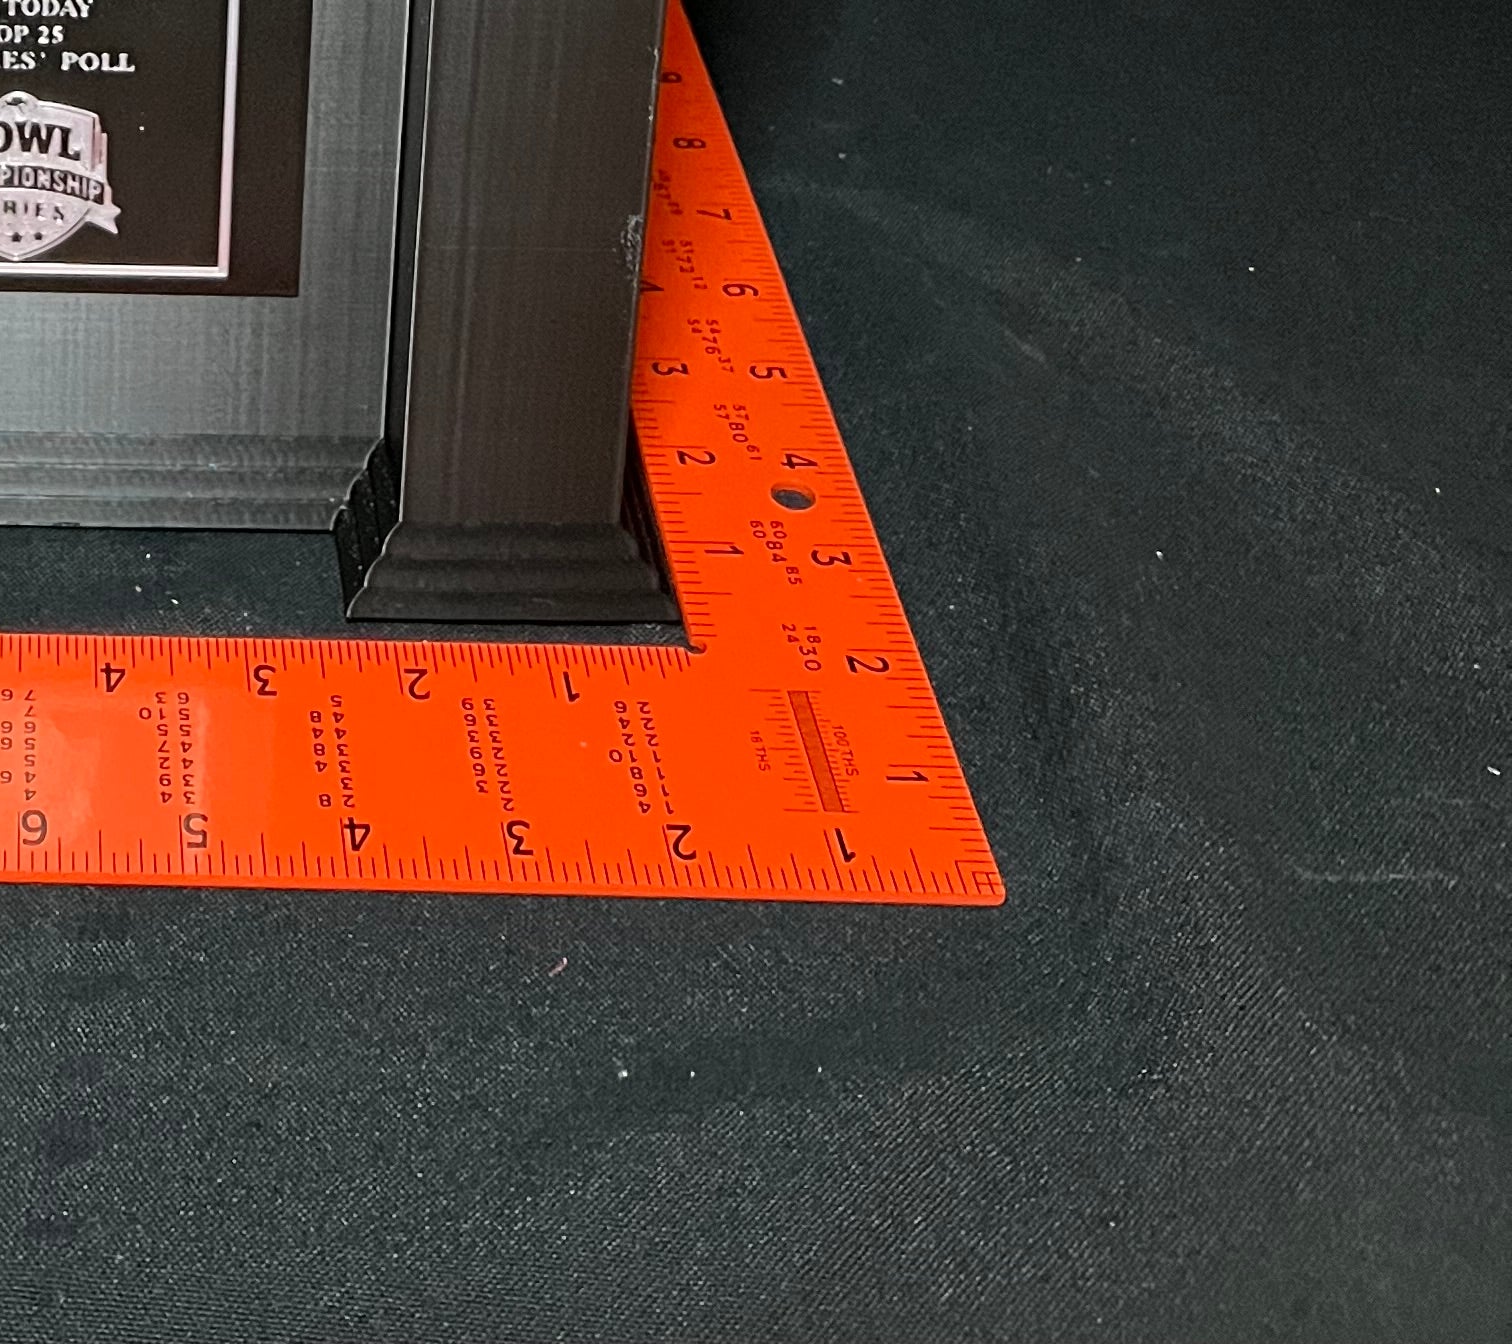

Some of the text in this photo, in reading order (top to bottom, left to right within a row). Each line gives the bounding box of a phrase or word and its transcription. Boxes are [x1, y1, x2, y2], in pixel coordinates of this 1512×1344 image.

[37, 25, 64, 44] 25
[60, 51, 136, 72] POLL
[651, 362, 689, 376] 3
[677, 450, 716, 465] 2
[704, 545, 745, 555] 1
[672, 137, 707, 149] 8
[696, 208, 733, 221] 7
[722, 283, 759, 297] 6
[749, 365, 788, 380] 5
[780, 453, 818, 470] 4
[811, 549, 853, 566] 3
[846, 655, 889, 673] 2
[886, 771, 928, 781] 1
[100, 663, 125, 692] 4
[254, 665, 277, 696] 3
[404, 669, 430, 699] 2
[563, 672, 580, 702] 1
[22, 810, 47, 845] 6
[184, 813, 208, 848] 5
[344, 817, 370, 851] 4
[506, 820, 533, 856] 3
[666, 824, 696, 860] 2
[835, 828, 856, 862] 1
